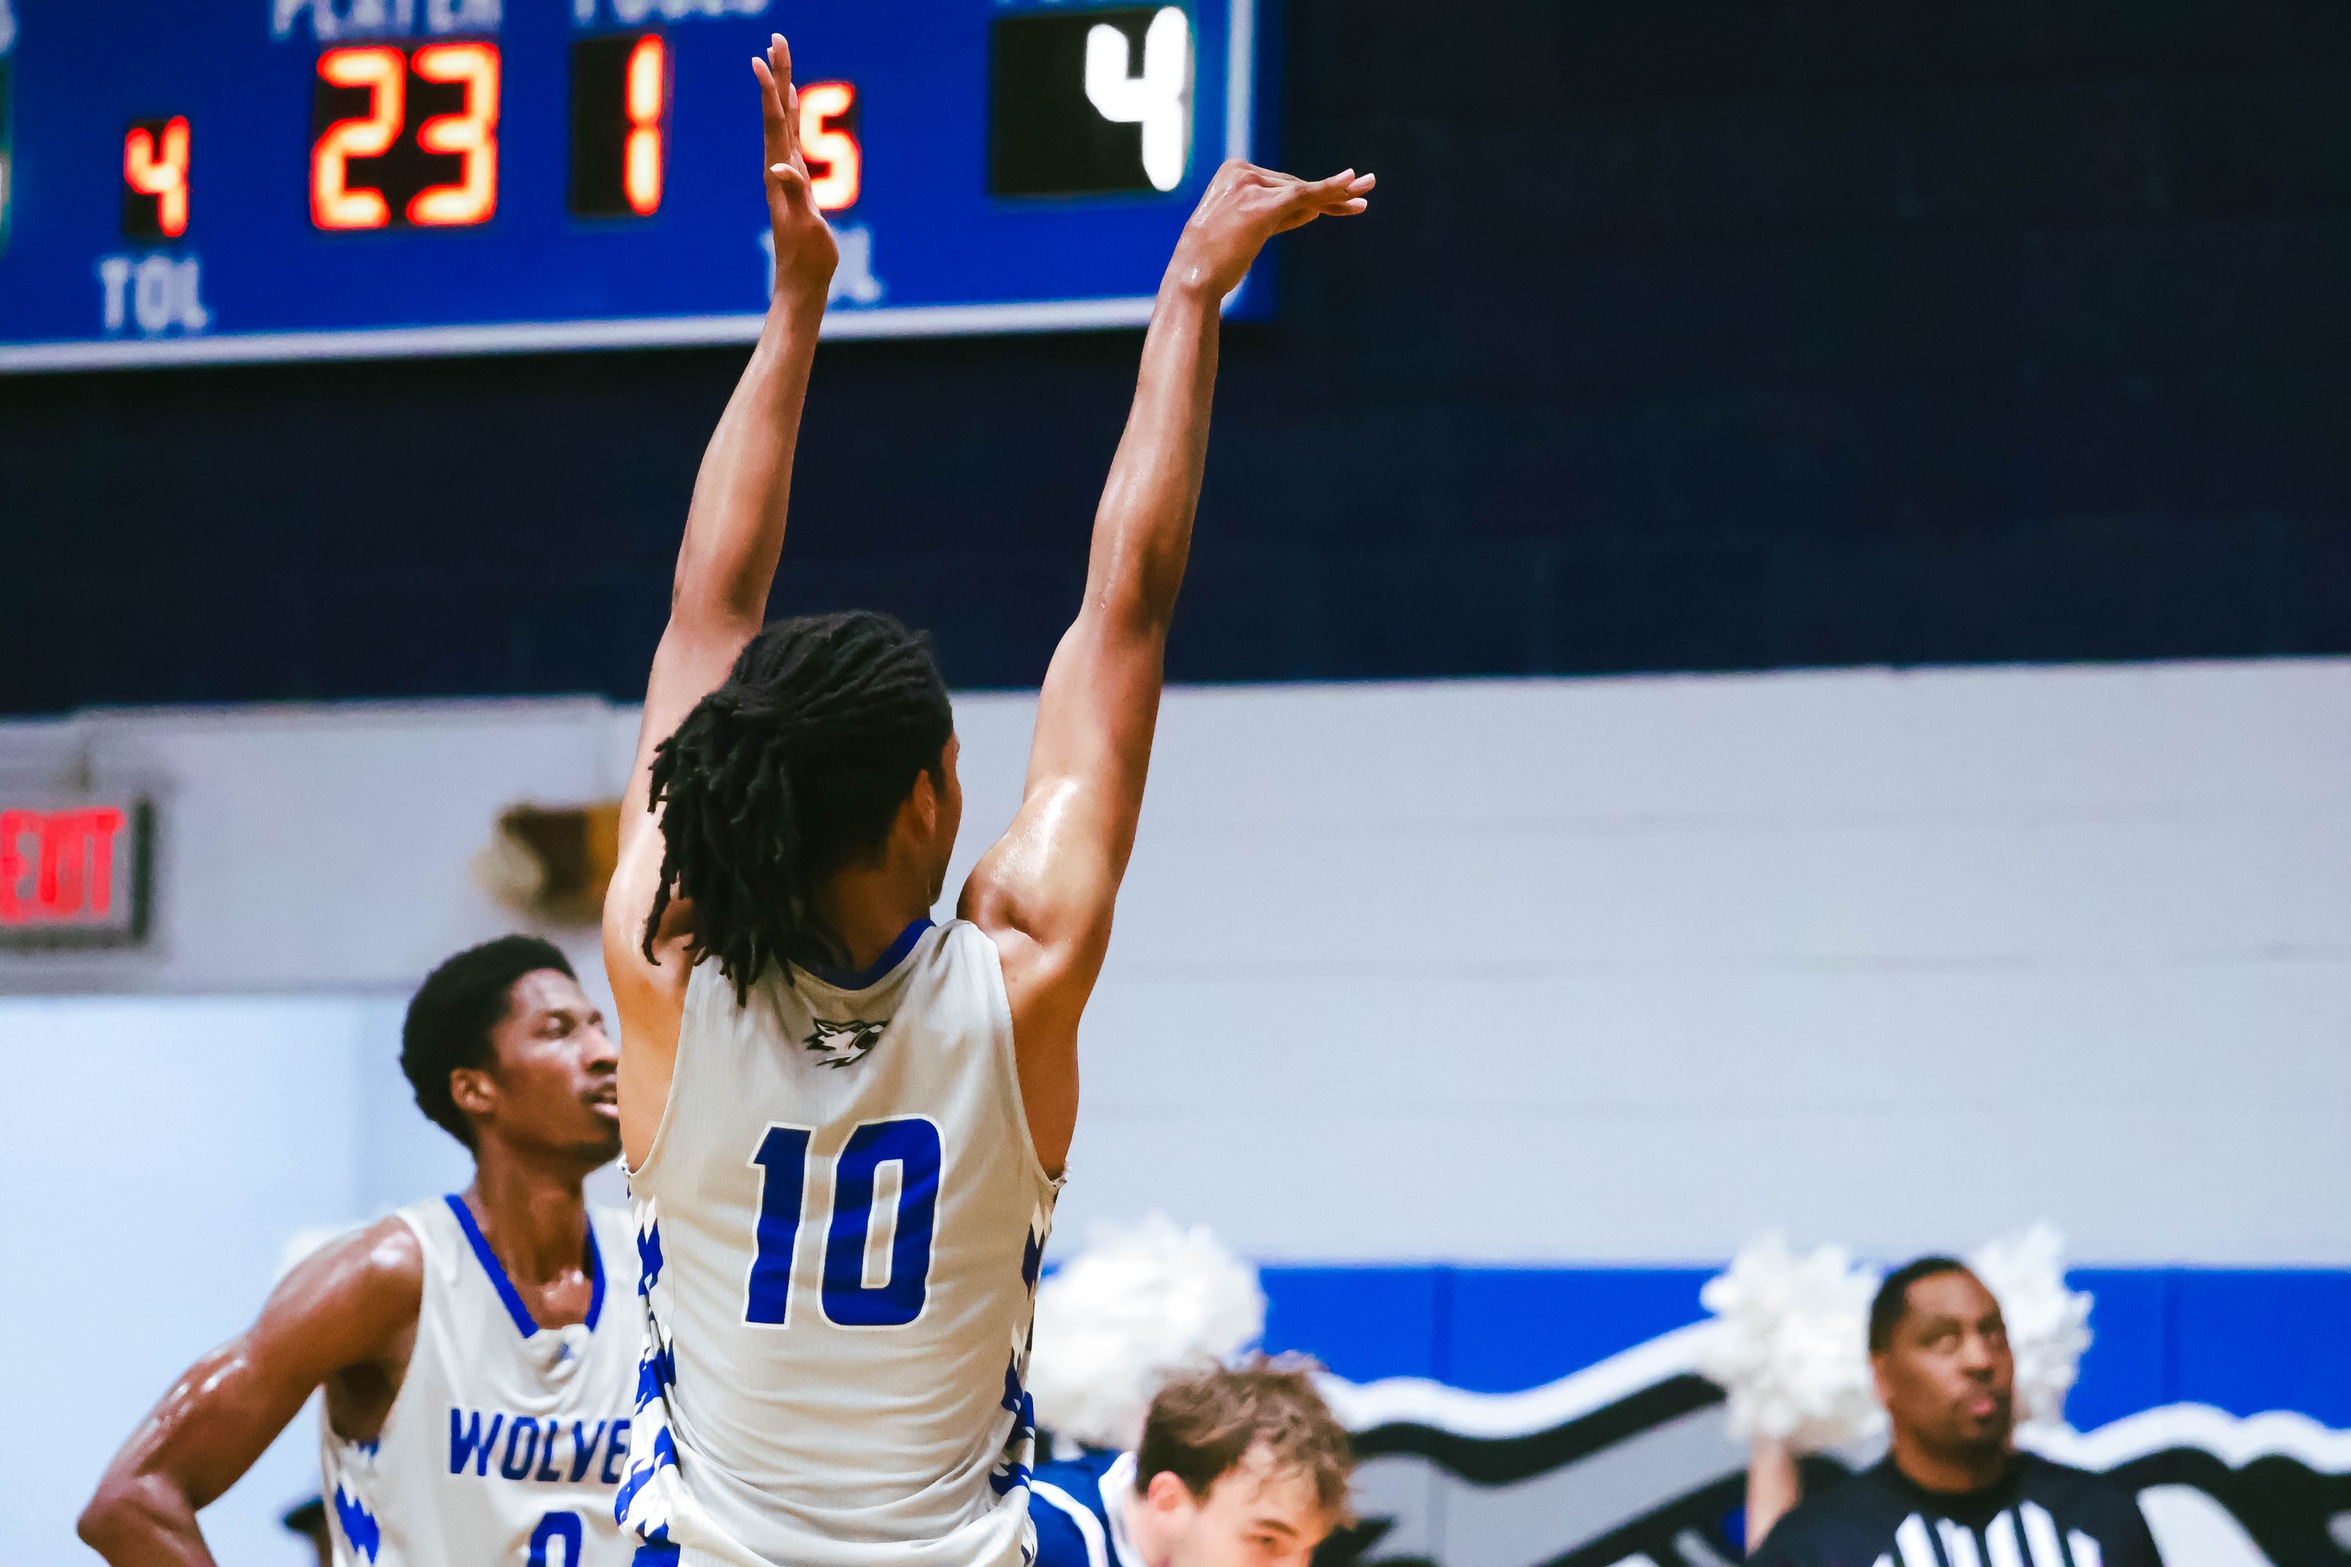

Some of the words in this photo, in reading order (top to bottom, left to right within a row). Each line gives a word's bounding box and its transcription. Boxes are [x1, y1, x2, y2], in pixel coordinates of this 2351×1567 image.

[124, 114, 191, 238] 4
[309, 41, 501, 230] 23
[624, 33, 665, 216] 1
[798, 81, 861, 211] 5
[1085, 6, 1188, 192] 4
[740, 1114, 944, 1330] 10
